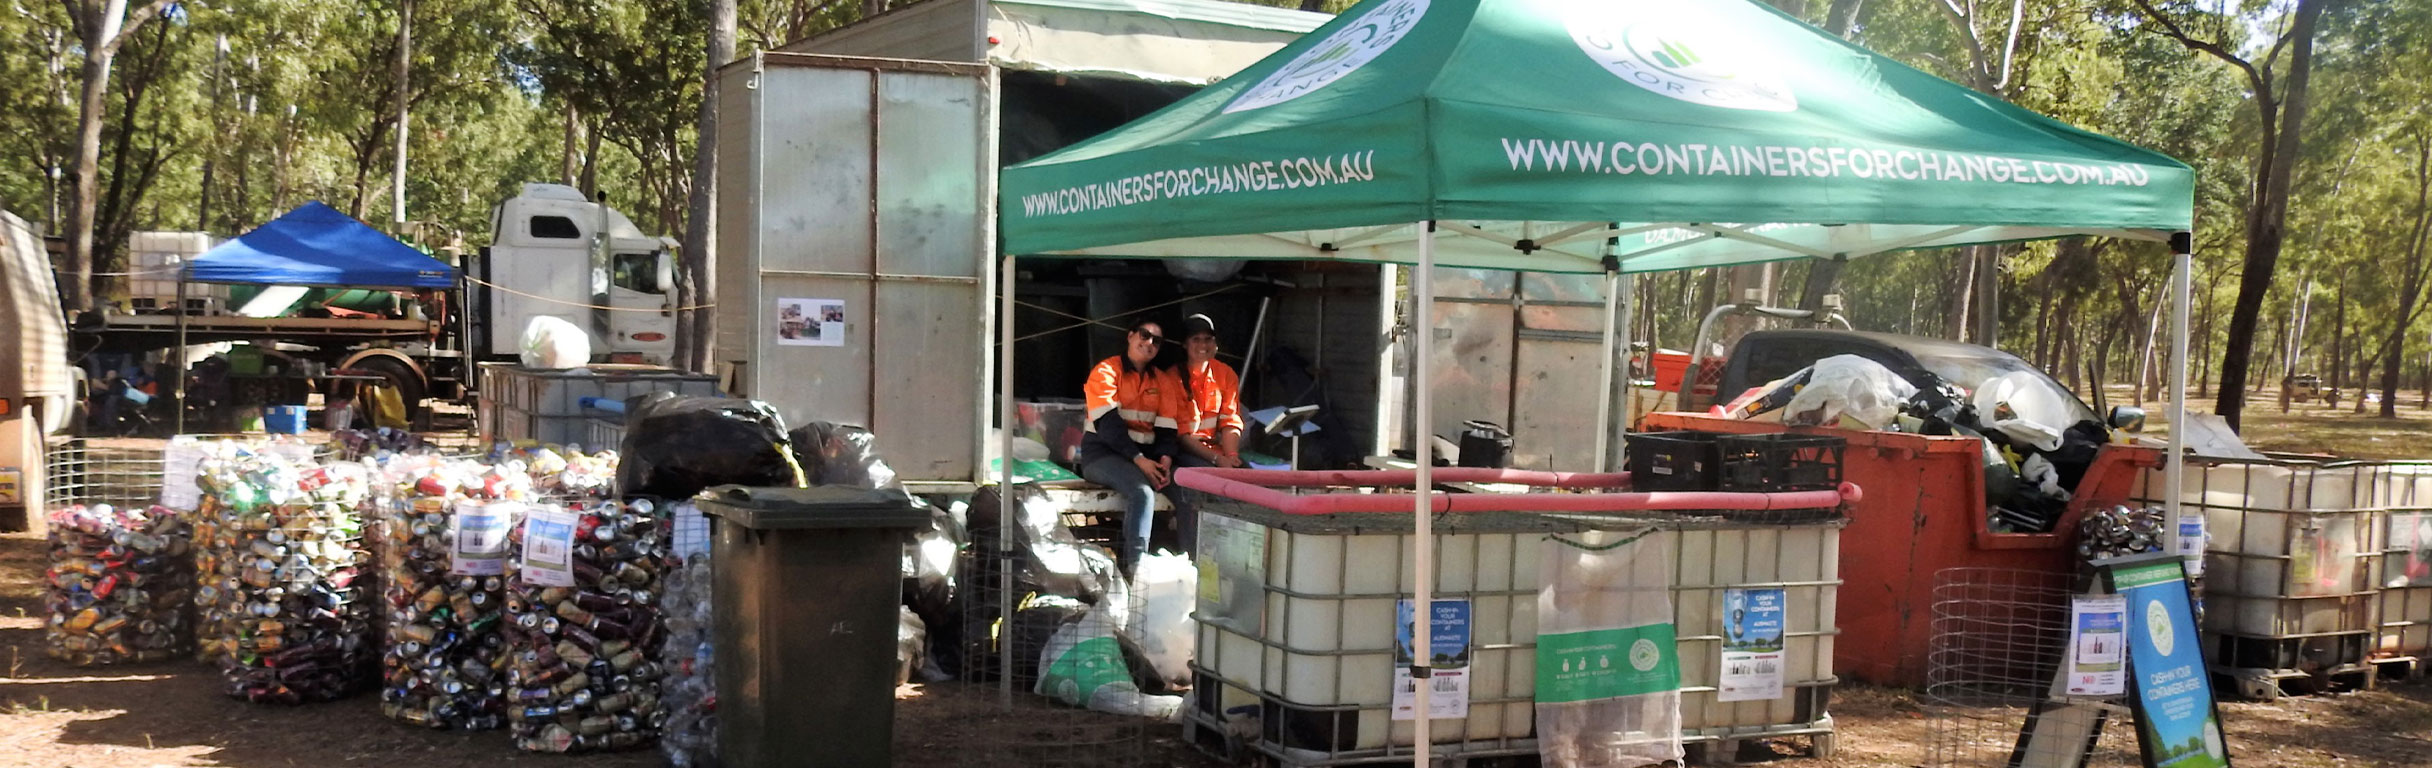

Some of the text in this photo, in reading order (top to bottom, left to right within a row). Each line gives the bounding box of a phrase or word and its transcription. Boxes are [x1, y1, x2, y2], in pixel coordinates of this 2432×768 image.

[1611, 59, 1685, 94] FOR
[1022, 150, 1374, 218] WWW.CONTAINERSFORCHANGE.COM.AU
[1501, 137, 2149, 187] WWW.CONTAINERSFORCHANGE.COM.AU
